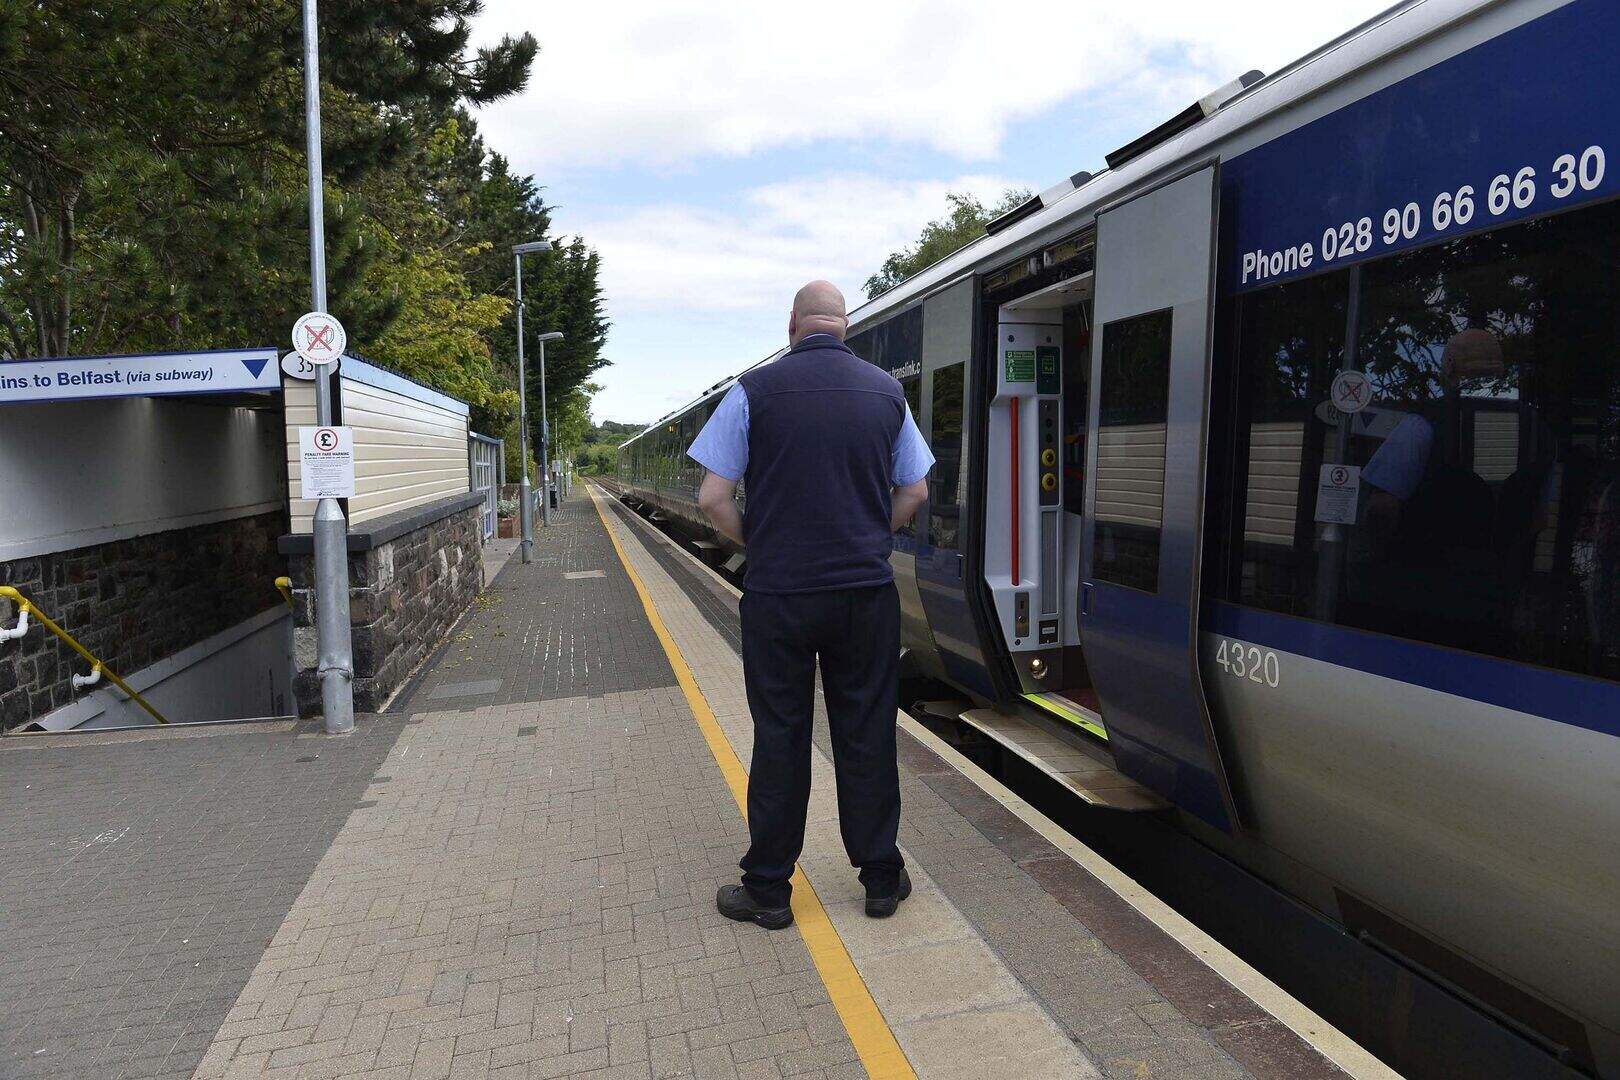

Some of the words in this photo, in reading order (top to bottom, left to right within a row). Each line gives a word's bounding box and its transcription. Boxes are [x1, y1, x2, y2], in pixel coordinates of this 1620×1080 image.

[1242, 242, 1314, 284] Phone
[1322, 216, 1373, 262] 028
[1382, 202, 1420, 245] 90
[1432, 185, 1475, 231] 66
[1487, 166, 1536, 216] 66
[1550, 145, 1606, 199] 30
[0, 375, 28, 389] ins
[33, 374, 52, 388] to
[57, 370, 122, 387] Belfast
[126, 370, 151, 385] (via
[154, 367, 213, 382] subway)
[1216, 639, 1280, 688] 4320
